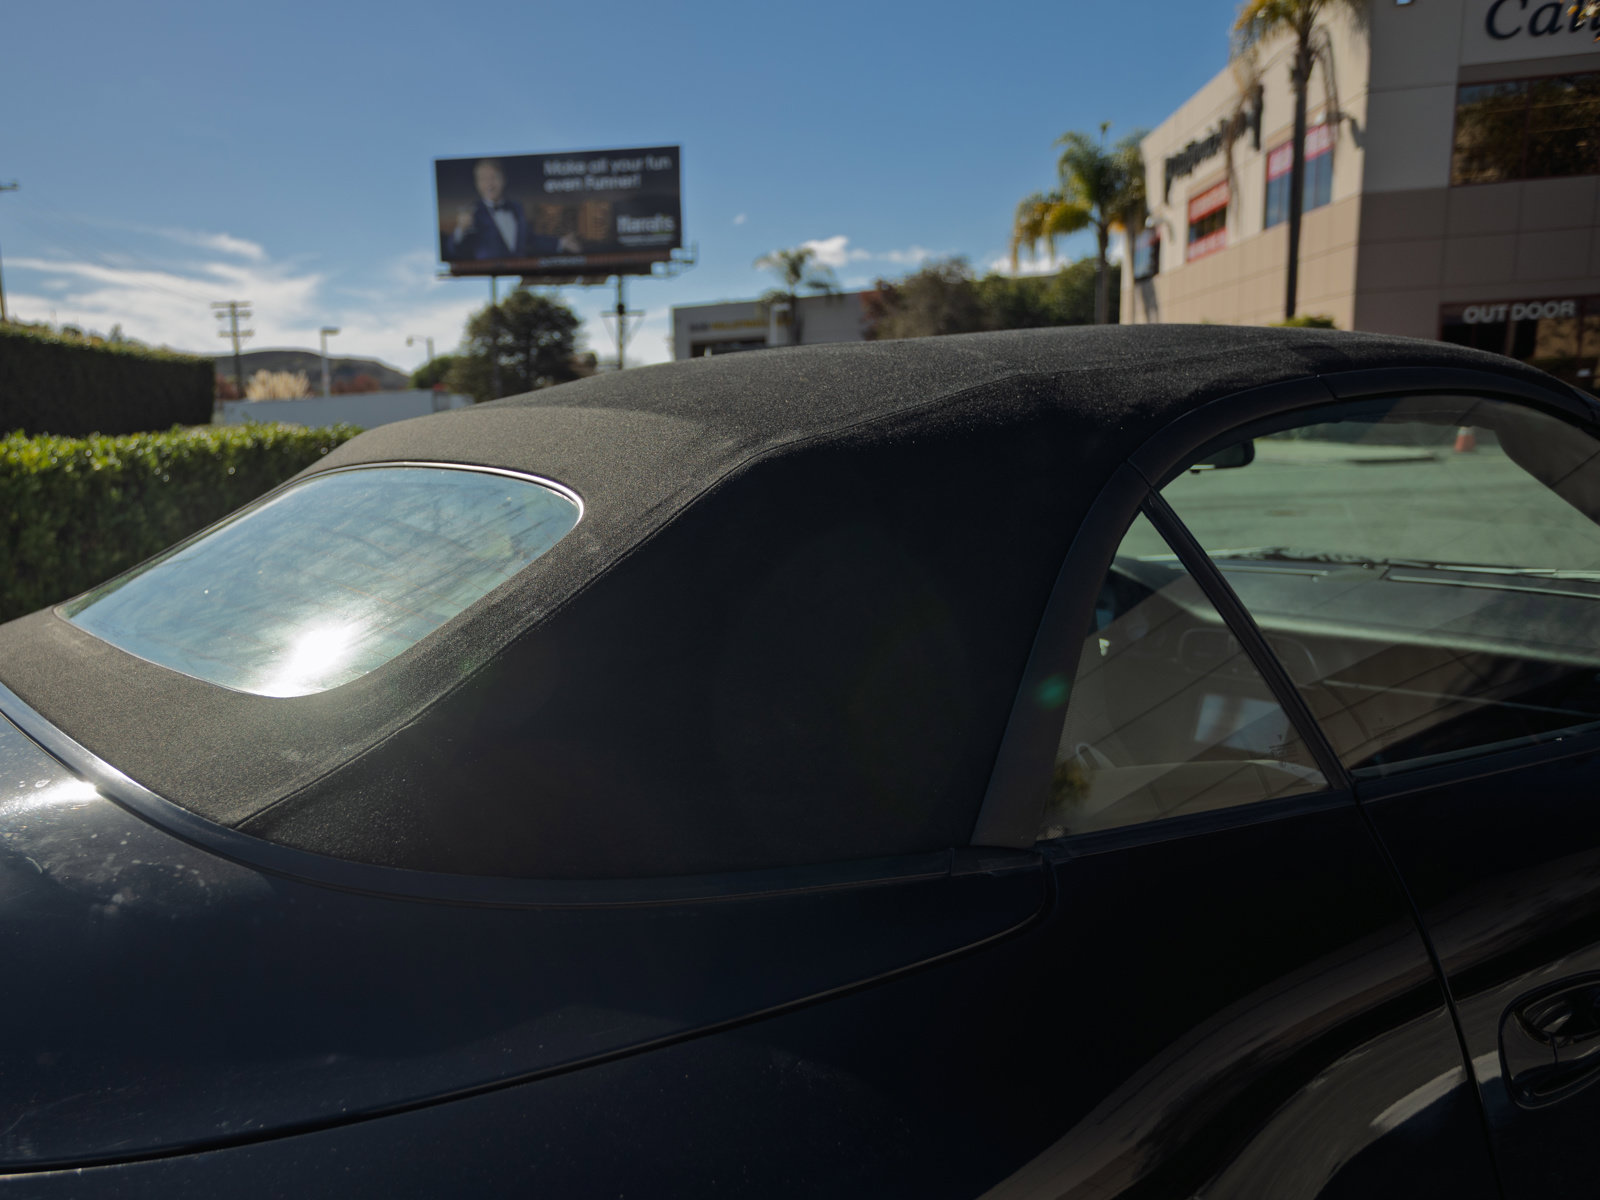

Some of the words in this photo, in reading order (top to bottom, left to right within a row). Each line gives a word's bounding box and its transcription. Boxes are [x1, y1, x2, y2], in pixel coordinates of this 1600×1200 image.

[543, 160, 586, 176] Make
[588, 158, 609, 174] all
[610, 158, 643, 176] your
[645, 154, 672, 171] fun
[543, 178, 582, 193] even
